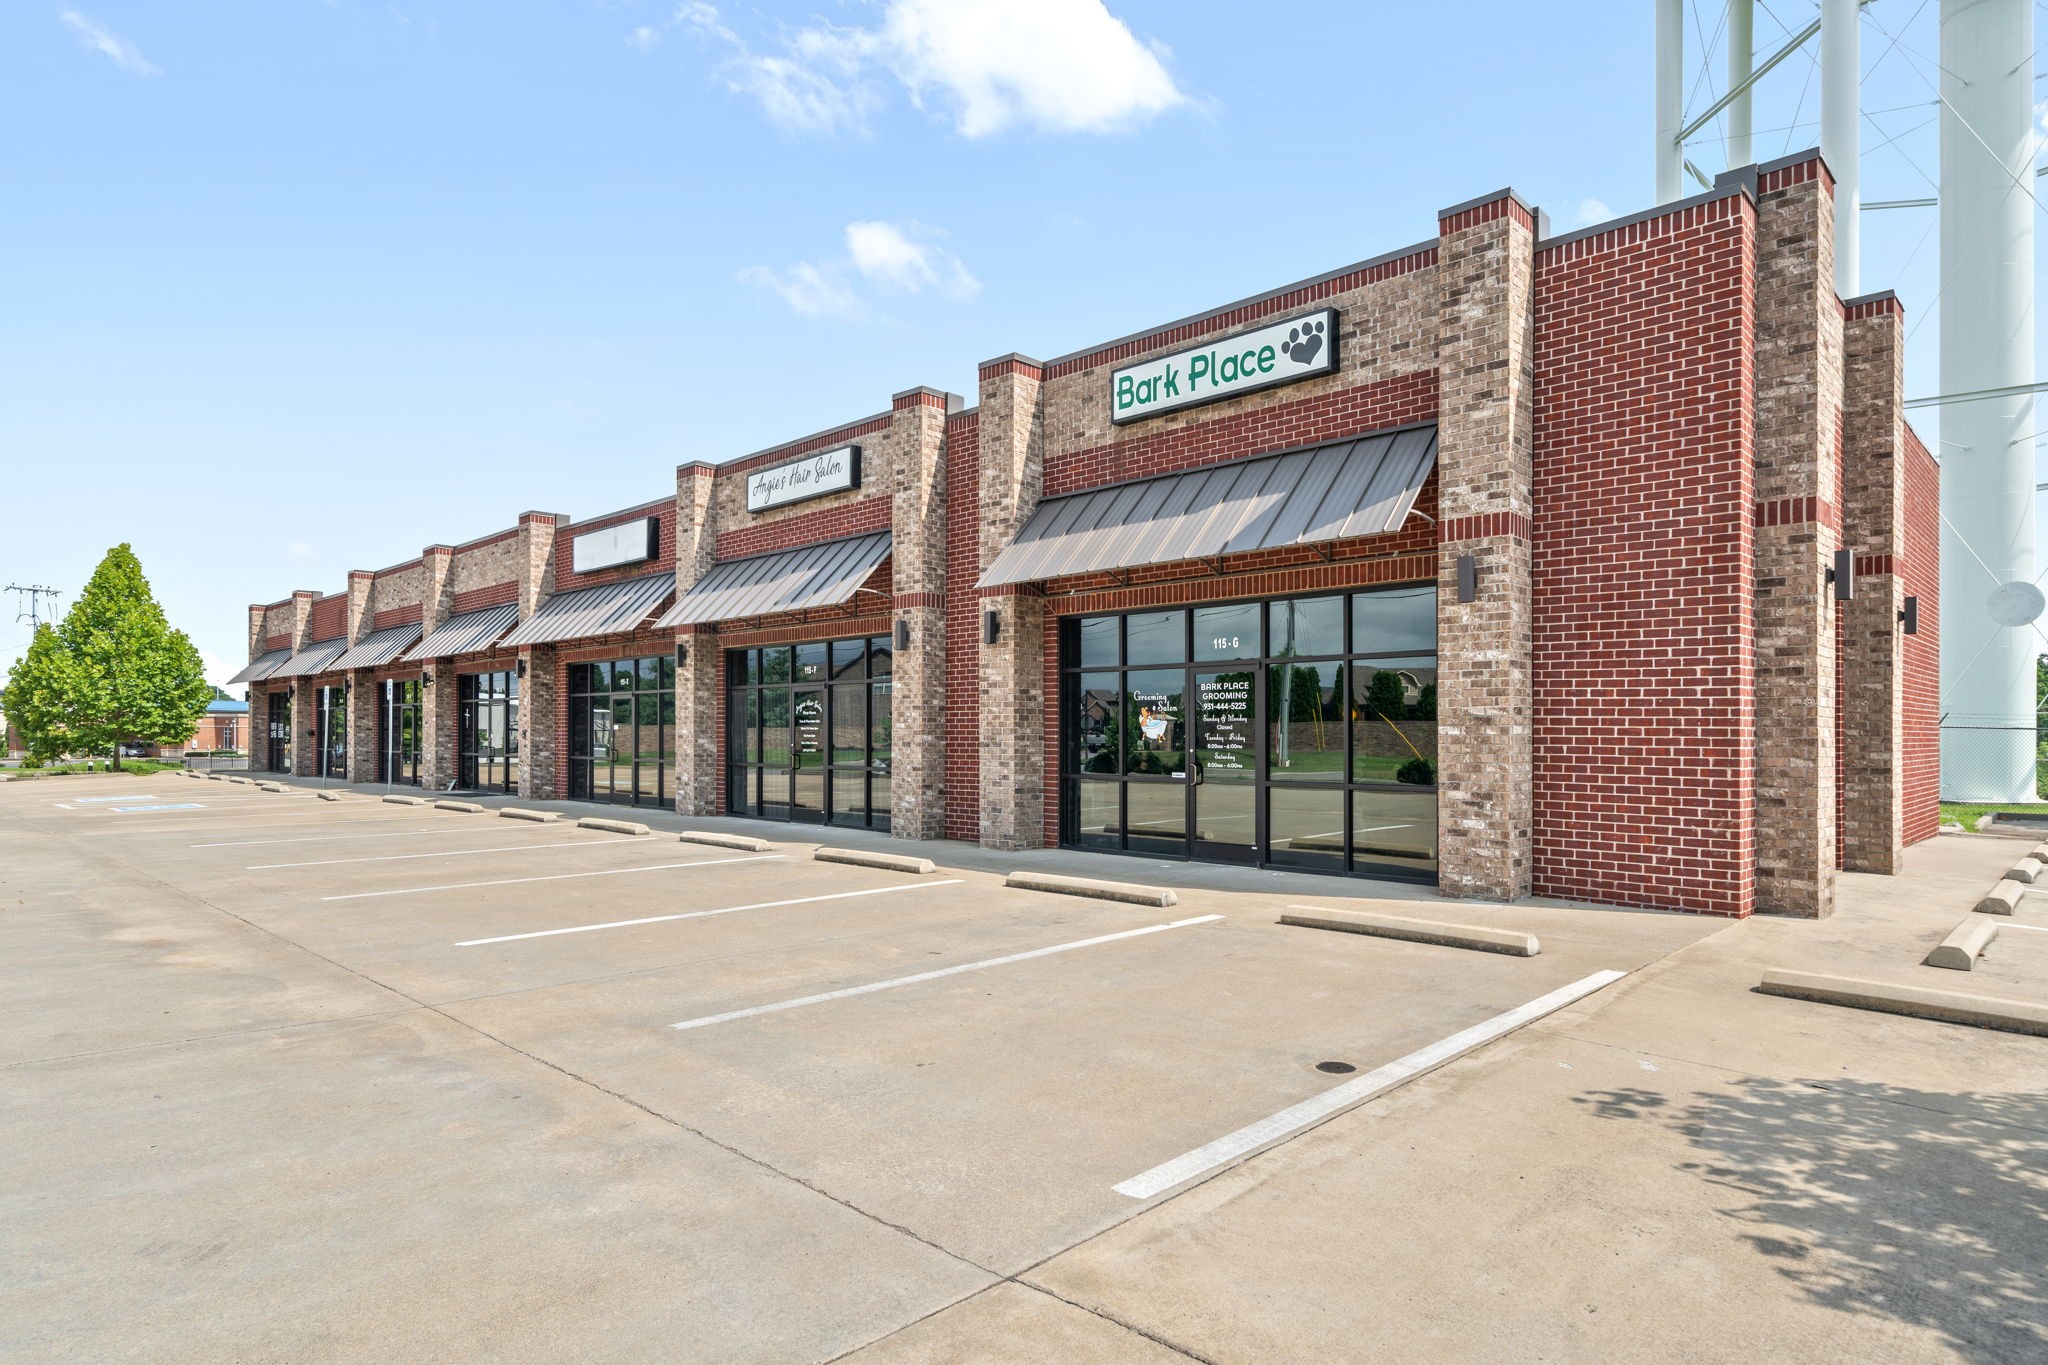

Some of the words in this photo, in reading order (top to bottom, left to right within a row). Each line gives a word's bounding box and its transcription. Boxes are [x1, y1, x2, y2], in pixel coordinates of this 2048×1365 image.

[1116, 363, 1180, 410] Bark
[1188, 344, 1276, 392] Place
[789, 463, 811, 488] Hair
[814, 455, 844, 484] Salon
[1200, 683, 1222, 691] BARK
[1223, 681, 1249, 690] PLACE
[1133, 690, 1167, 703] Grooming
[1202, 691, 1248, 700] GROOMING
[1157, 700, 1178, 712] Salon
[1203, 702, 1247, 710] 931-444-5225
